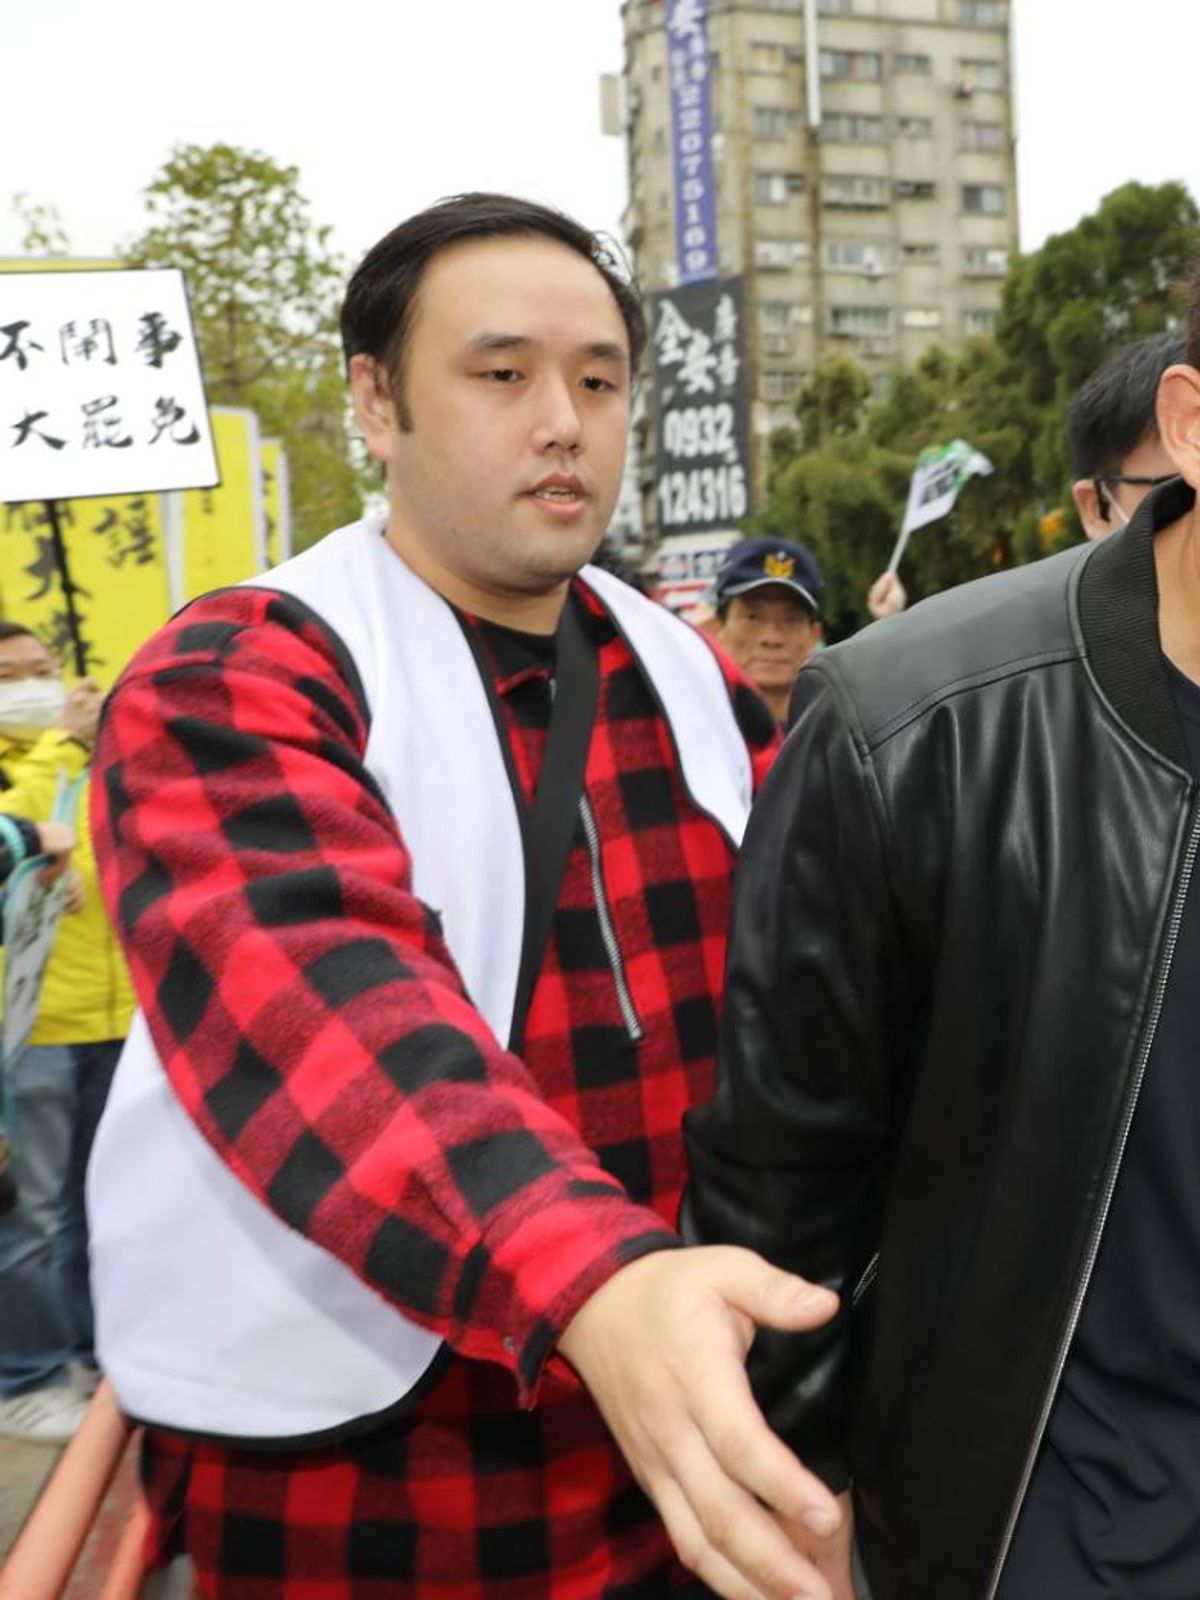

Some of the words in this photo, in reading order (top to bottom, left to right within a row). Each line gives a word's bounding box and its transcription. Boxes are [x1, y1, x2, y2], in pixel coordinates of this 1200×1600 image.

[11, 395, 201, 450] 大罷免
[657, 465, 746, 526] 124316
